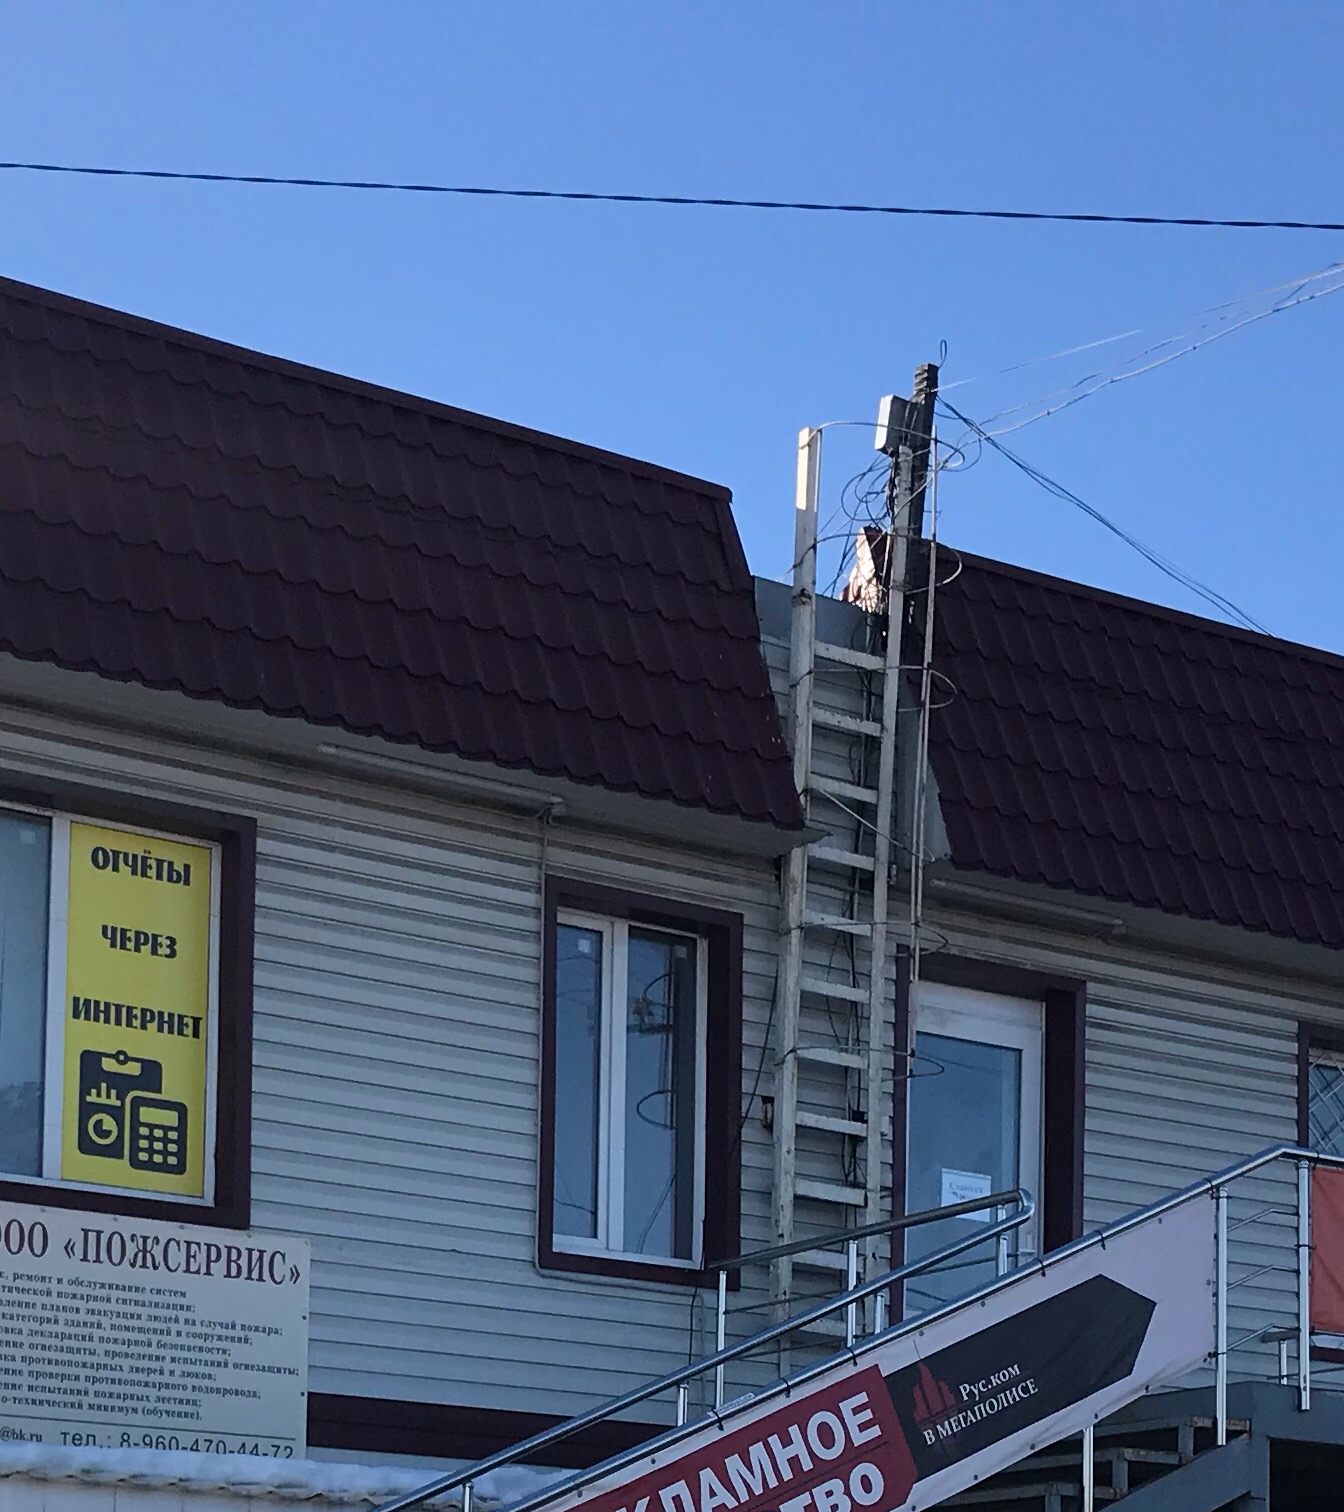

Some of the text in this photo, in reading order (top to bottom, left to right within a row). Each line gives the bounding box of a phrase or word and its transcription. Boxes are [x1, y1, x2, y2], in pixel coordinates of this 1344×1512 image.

[91, 846, 192, 887] ОТЧЁТЫ
[101, 924, 178, 959] ЧЕРЕЗ
[72, 996, 203, 1039] ИНТЕРНЕТ
[64, 1226, 301, 1287] «ПОЖСЕРВИС»
[12, 1271, 53, 1284] ремонт
[67, 1276, 146, 1294] обслуживание
[149, 1286, 187, 1299] систем
[56, 1289, 112, 1305] пожарной
[1, 1311, 60, 1326] категорий
[110, 1324, 172, 1337] помещений
[186, 1331, 253, 1346] сооружений;
[41, 1301, 81, 1315] планов
[84, 1307, 142, 1322] эвакуации
[146, 1312, 180, 1325] людей
[200, 1319, 237, 1331] случай
[240, 1323, 283, 1337] пожара;
[27, 1328, 94, 1343] деклараций
[98, 1336, 152, 1349] пожарной
[156, 1338, 232, 1358] безопасности;
[20, 1355, 124, 1373] противопожарных
[127, 1364, 164, 1377] дверей
[104, 1350, 167, 1363] проведение
[170, 1353, 229, 1369] испытаний
[27, 1369, 81, 1384] проверки
[84, 1375, 188, 1393] противопожарного
[27, 1383, 90, 1398] испытаний
[93, 1390, 151, 1404] пожарных
[958, 1363, 1021, 1403] Рус.ком
[87, 1401, 139, 1416] минимум
[923, 1378, 1039, 1446] В МЕГАПОЛИСЕ
[119, 1431, 294, 1459] 8-960-470-44-72
